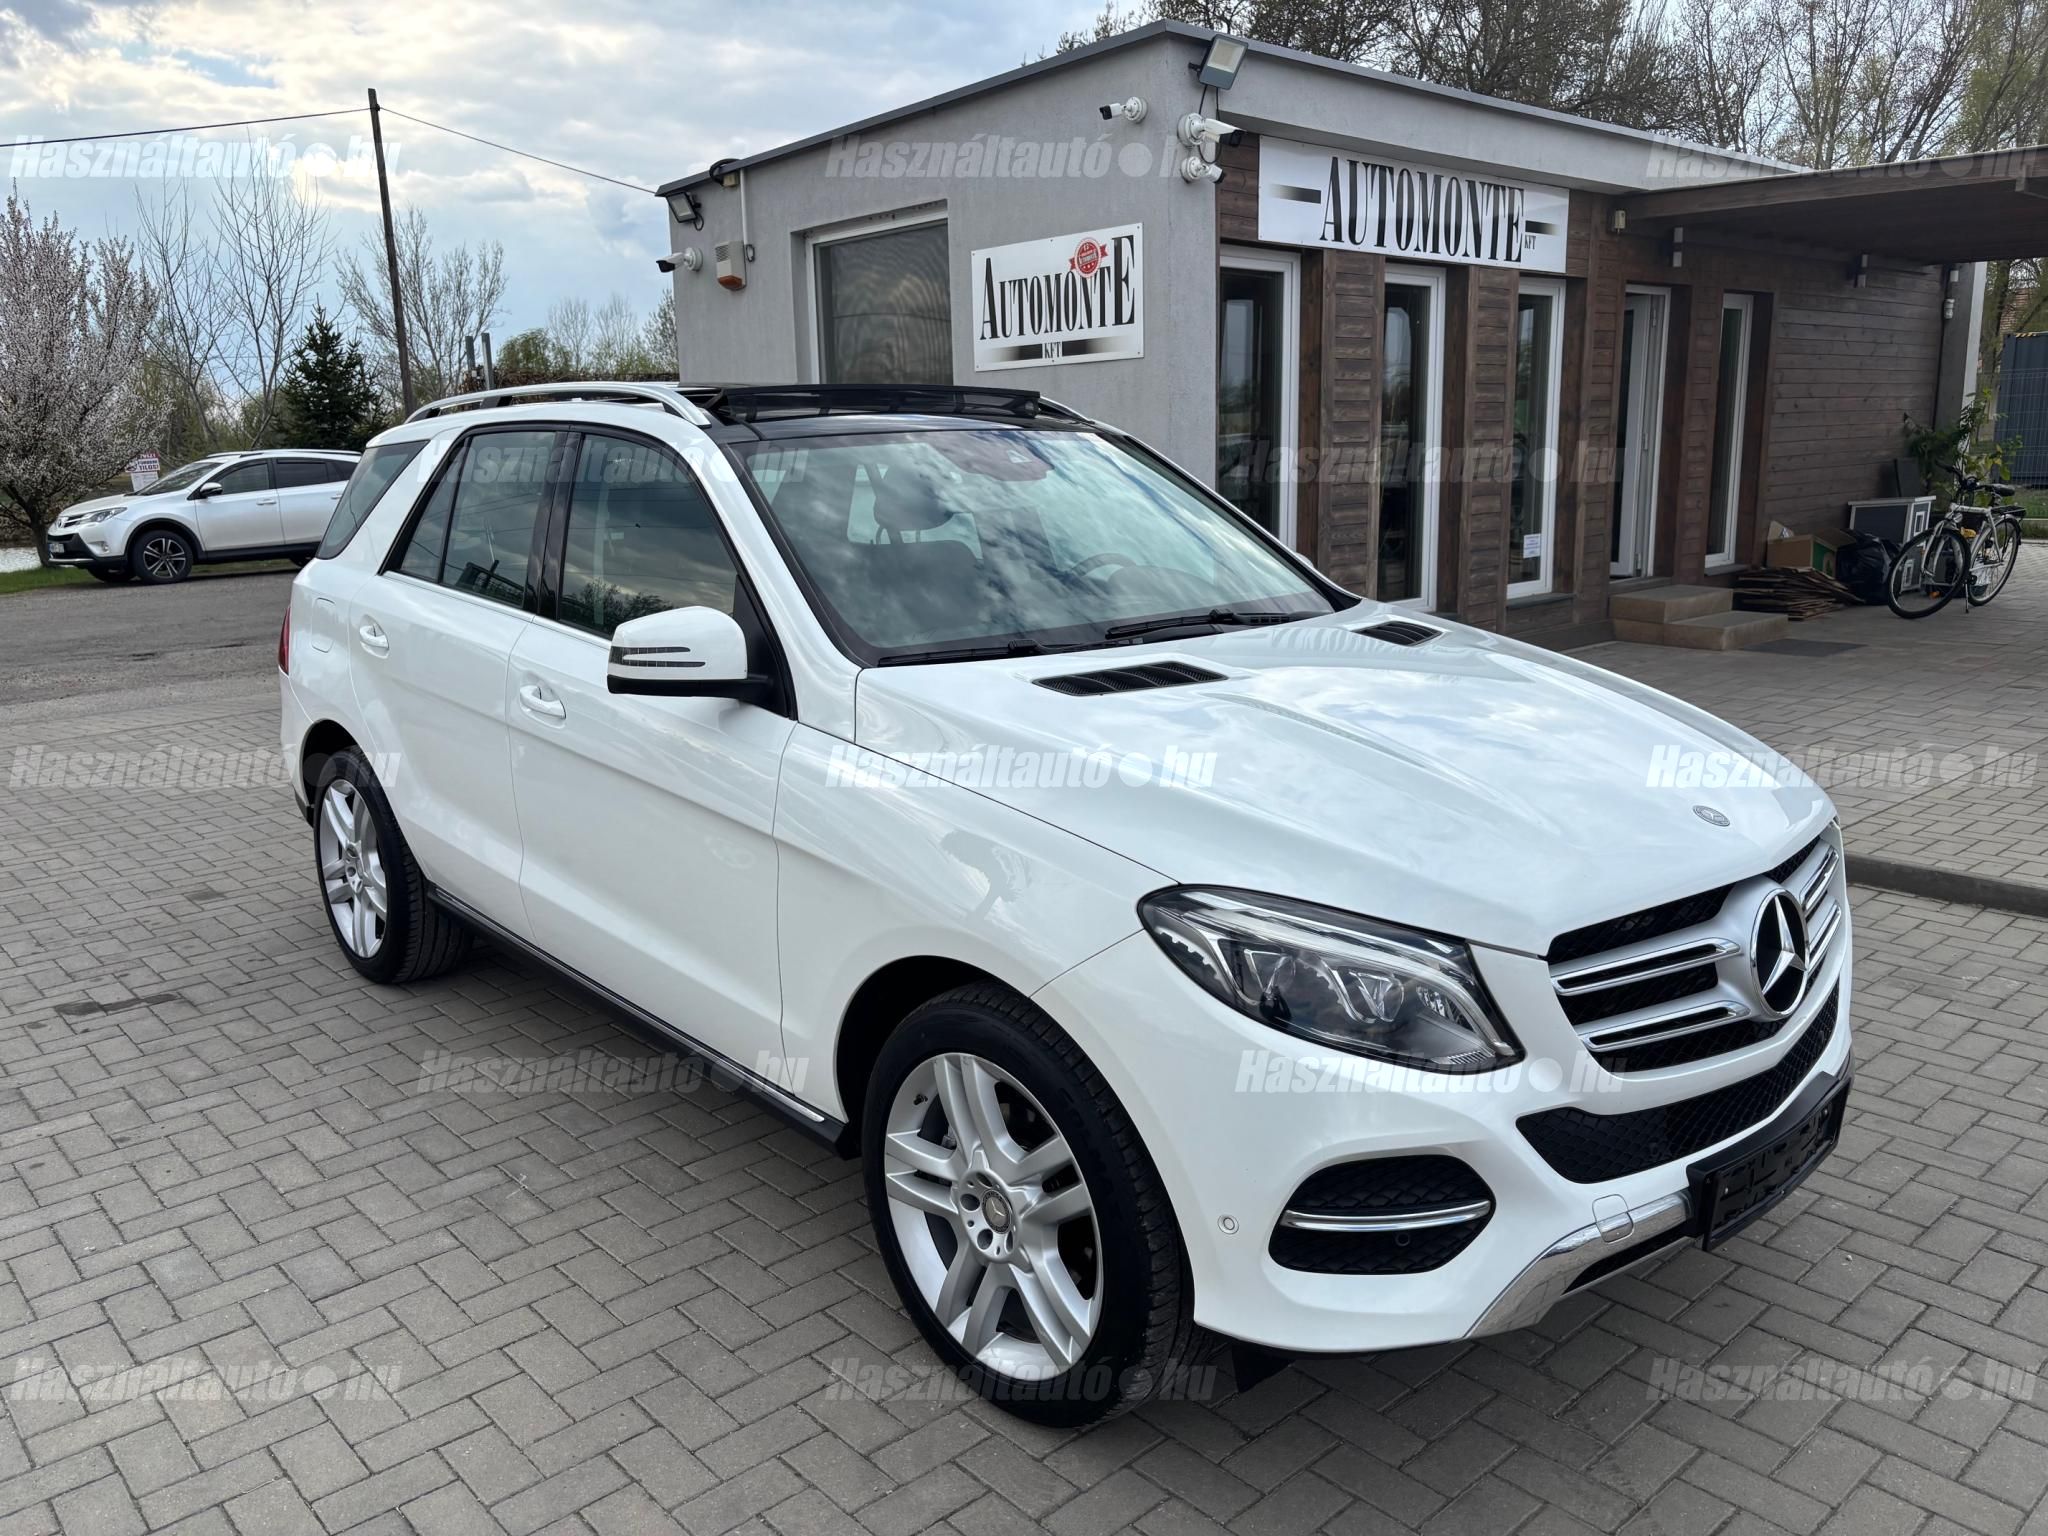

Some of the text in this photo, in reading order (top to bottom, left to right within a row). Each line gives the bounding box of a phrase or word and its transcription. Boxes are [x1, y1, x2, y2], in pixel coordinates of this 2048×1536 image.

[1319, 156, 1524, 263] AUTOMONTE
[980, 234, 1135, 340] AUTOMONTE
[1044, 341, 1062, 359] KFT
